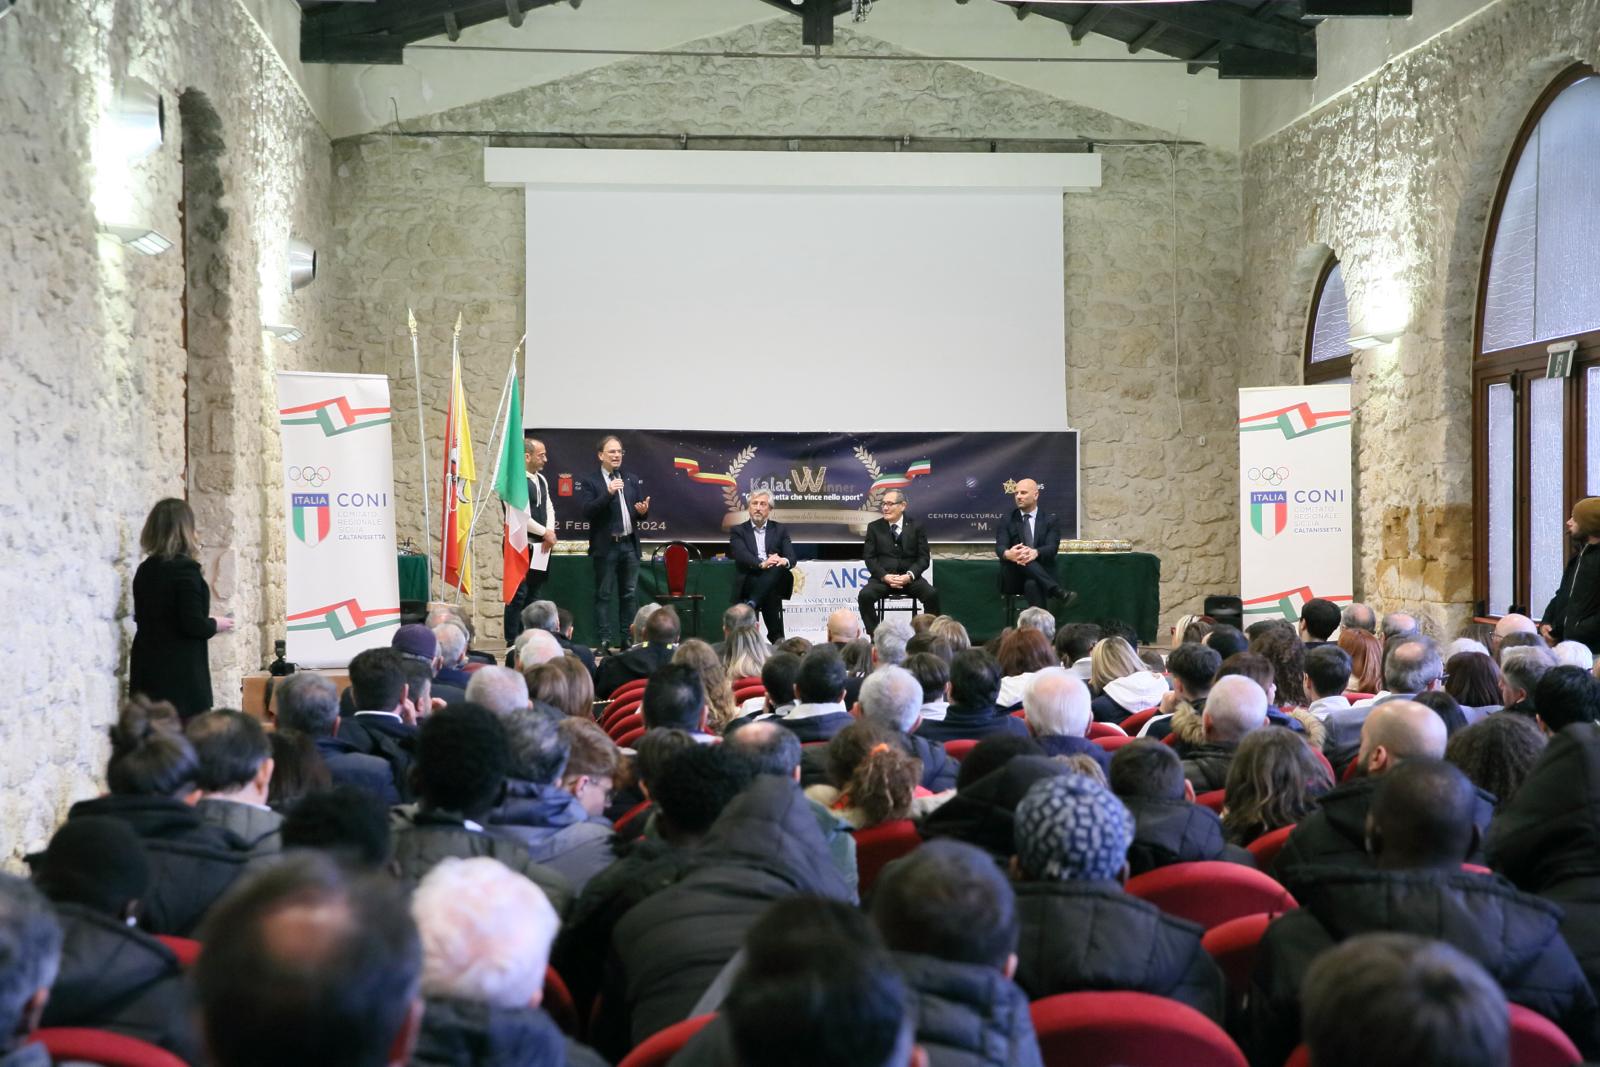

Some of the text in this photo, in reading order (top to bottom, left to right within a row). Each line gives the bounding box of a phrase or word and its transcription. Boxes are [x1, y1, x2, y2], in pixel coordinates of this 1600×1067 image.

[750, 476, 792, 492] Kalat
[294, 496, 327, 504] ITALIA
[336, 492, 387, 507] CONI
[791, 492, 803, 501] che
[804, 493, 822, 501] vince
[823, 493, 841, 501] nello
[1253, 494, 1285, 502] ITALIA
[1294, 489, 1344, 503] CONI
